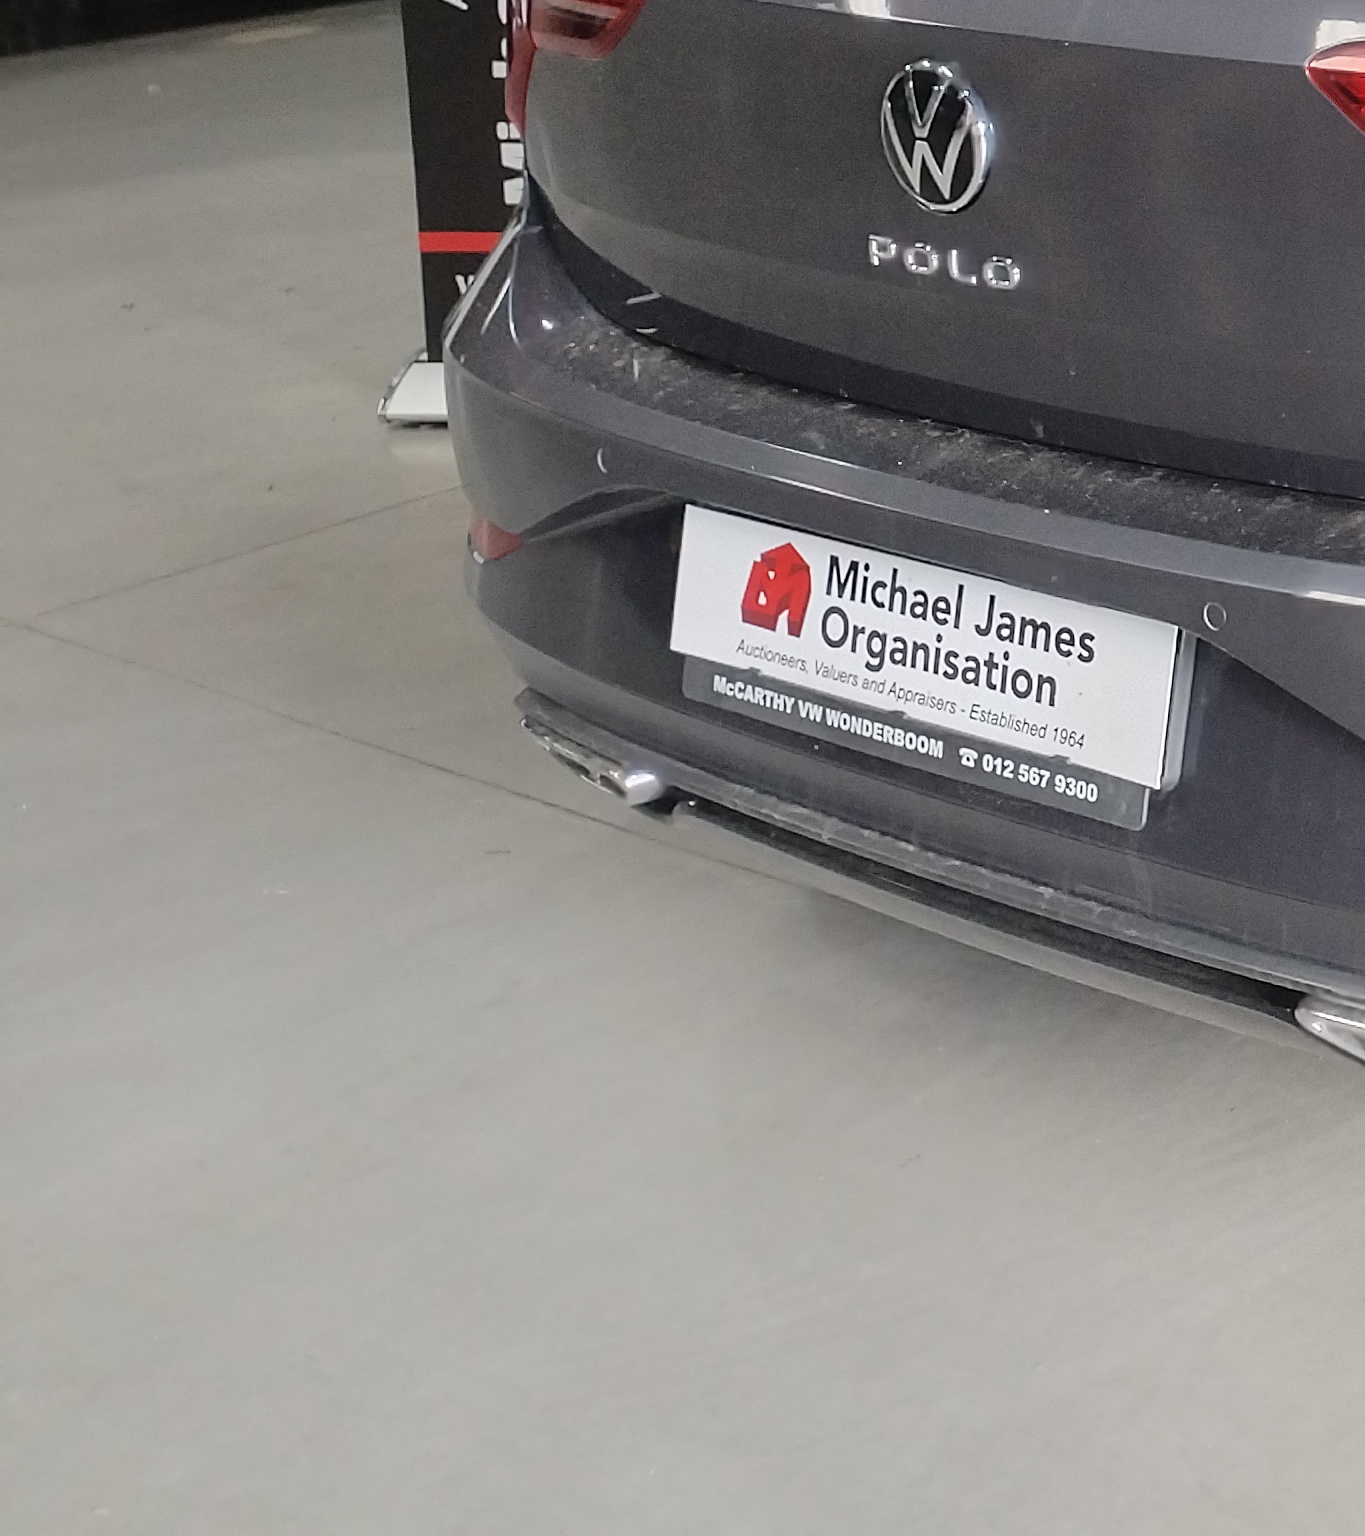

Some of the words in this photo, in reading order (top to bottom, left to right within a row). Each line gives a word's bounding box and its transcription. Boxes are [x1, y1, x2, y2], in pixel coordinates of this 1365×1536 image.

[868, 234, 1022, 289] POLO
[821, 607, 1057, 707] Organisation
[826, 554, 964, 629] Michael
[975, 595, 1096, 664] James
[713, 673, 795, 715] McCARTHY
[798, 697, 824, 723] VW
[825, 707, 944, 759] WONDERBOOM
[982, 754, 1015, 781] 012
[1018, 763, 1051, 791] 567
[1055, 773, 1098, 803] 9300
[736, 638, 808, 675] Auctioneers,
[815, 659, 859, 688] Valuers
[862, 672, 886, 696] and
[888, 681, 957, 716] Appraisers
[969, 703, 1048, 741] Established
[1053, 725, 1086, 750] 1964
